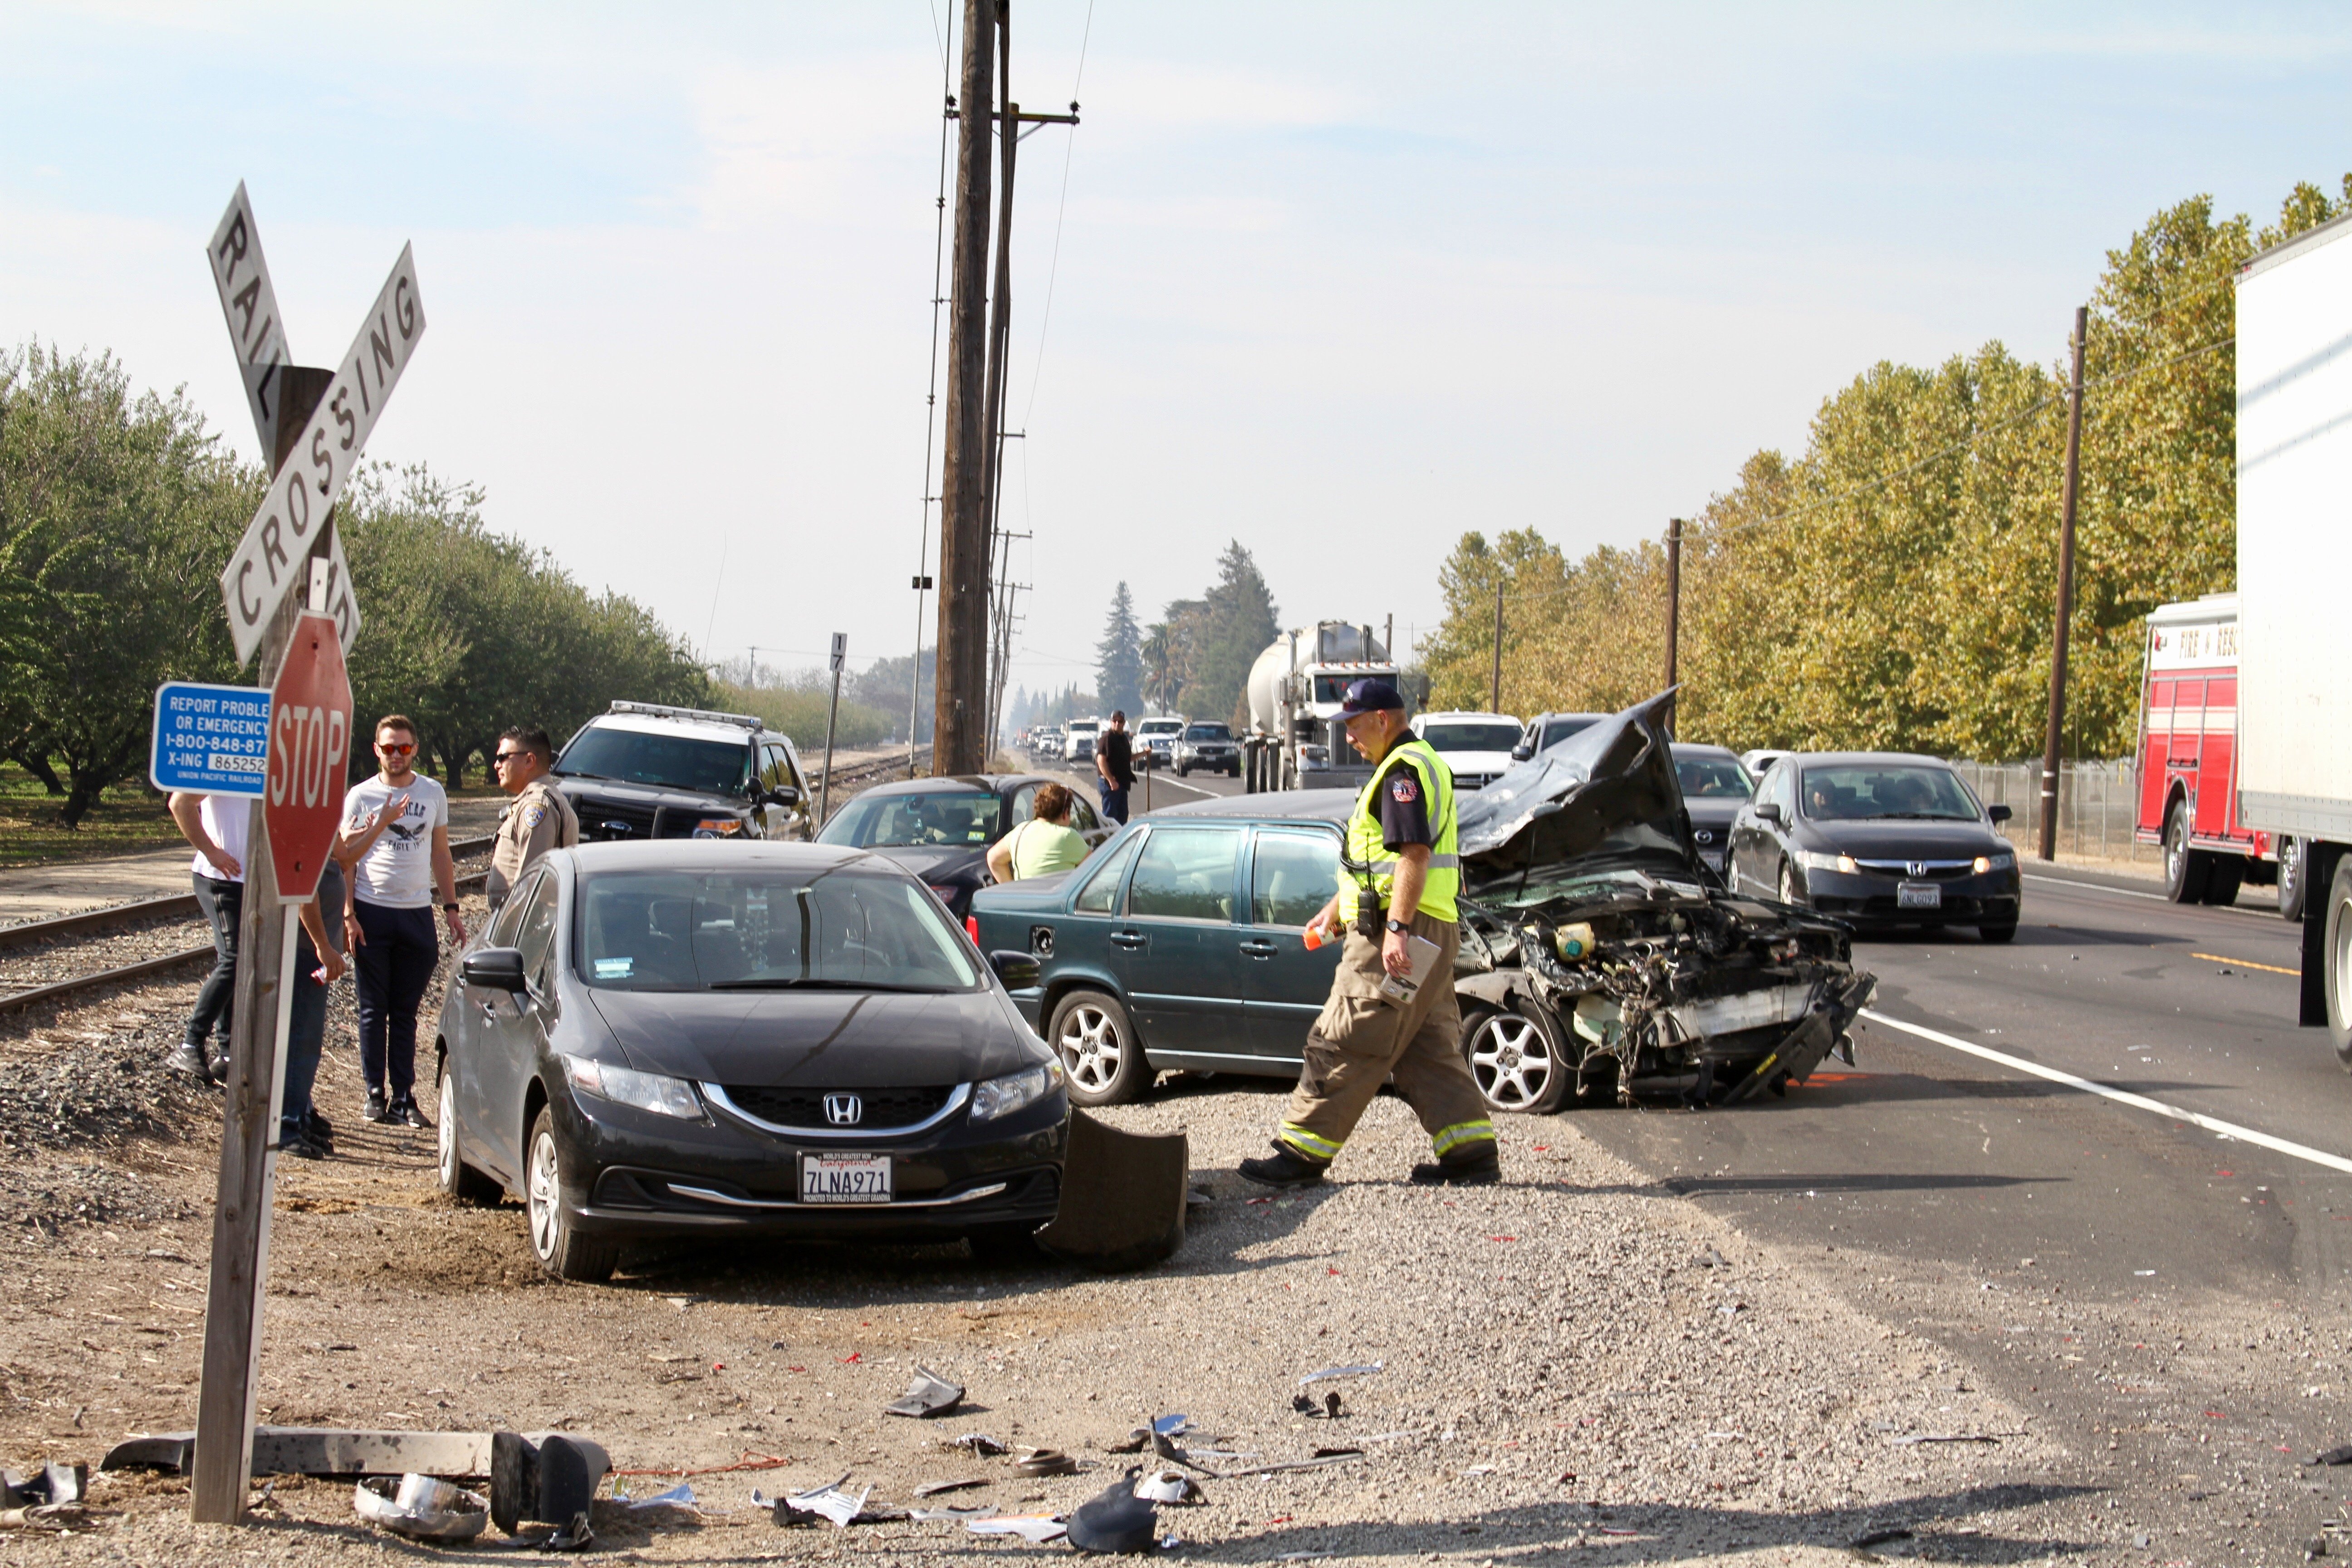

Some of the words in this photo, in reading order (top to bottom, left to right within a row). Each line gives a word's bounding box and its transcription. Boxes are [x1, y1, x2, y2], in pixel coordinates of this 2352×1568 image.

[238, 276, 415, 627] CROSSING
[2180, 630, 2199, 658] FIRE
[2217, 626, 2238, 657] RESC
[170, 696, 217, 713] REPORT
[221, 700, 269, 718] PROBLE
[176, 715, 193, 730] OR
[196, 716, 268, 736] EMERGENCY
[166, 733, 267, 754] 1-800-848-87
[168, 751, 202, 767] X-ING
[215, 756, 265, 772] 865252
[271, 703, 345, 808] STOP
[177, 771, 199, 779] UNION
[201, 772, 226, 782] PACIFIC
[228, 774, 262, 784] RAILROAD
[388, 839, 409, 851] EAGLE
[806, 1171, 887, 1194] 7LNA971
[804, 1194, 826, 1202] PROMOTED
[832, 1194, 850, 1202] WORLD'S
[850, 1194, 870, 1202] GREATEST
[871, 1194, 890, 1202] GRANDMA
